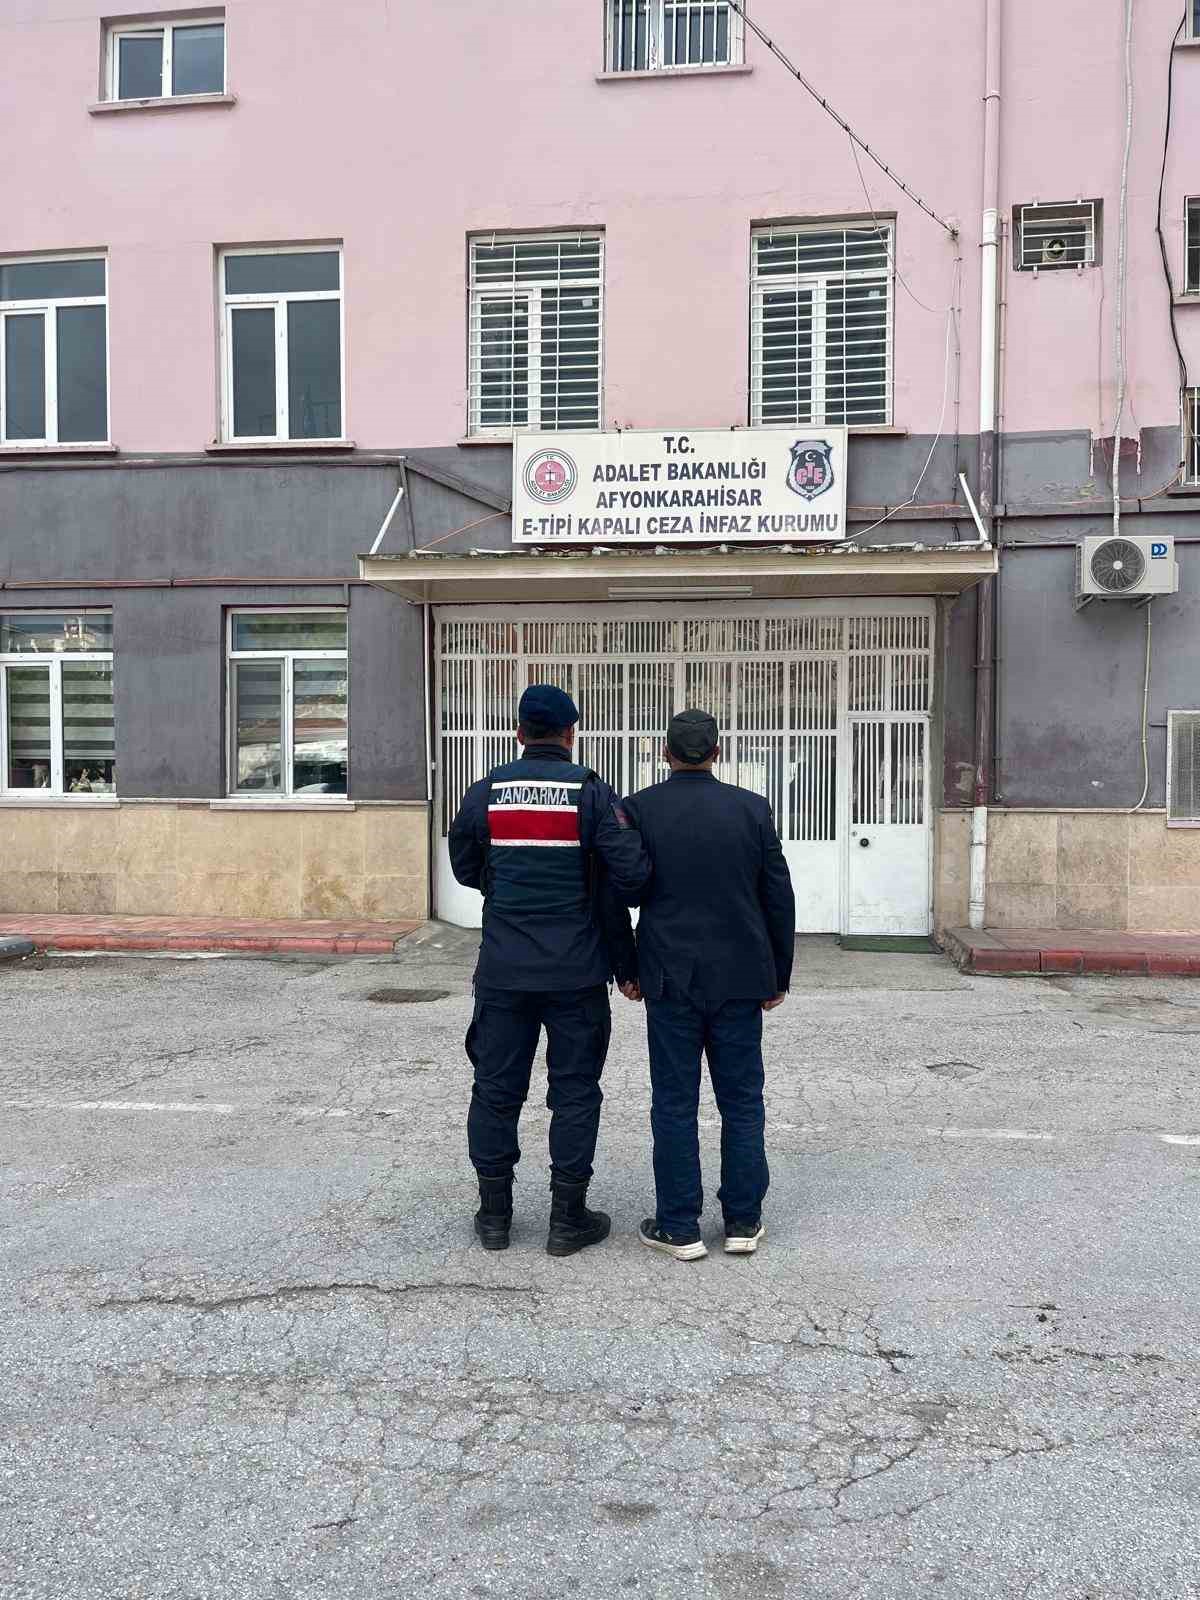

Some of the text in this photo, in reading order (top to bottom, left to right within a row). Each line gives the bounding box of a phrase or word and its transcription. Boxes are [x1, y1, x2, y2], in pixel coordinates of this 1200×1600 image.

[663, 436, 695, 454] T.C.
[592, 457, 766, 482] ADALET BAKANLIĞI
[596, 485, 762, 509] AFYONKARAHİSAR
[522, 511, 839, 535] E-TİPİ KAPALI CEZA İNFAZ KURUMU
[496, 786, 570, 805] JANDARMA
